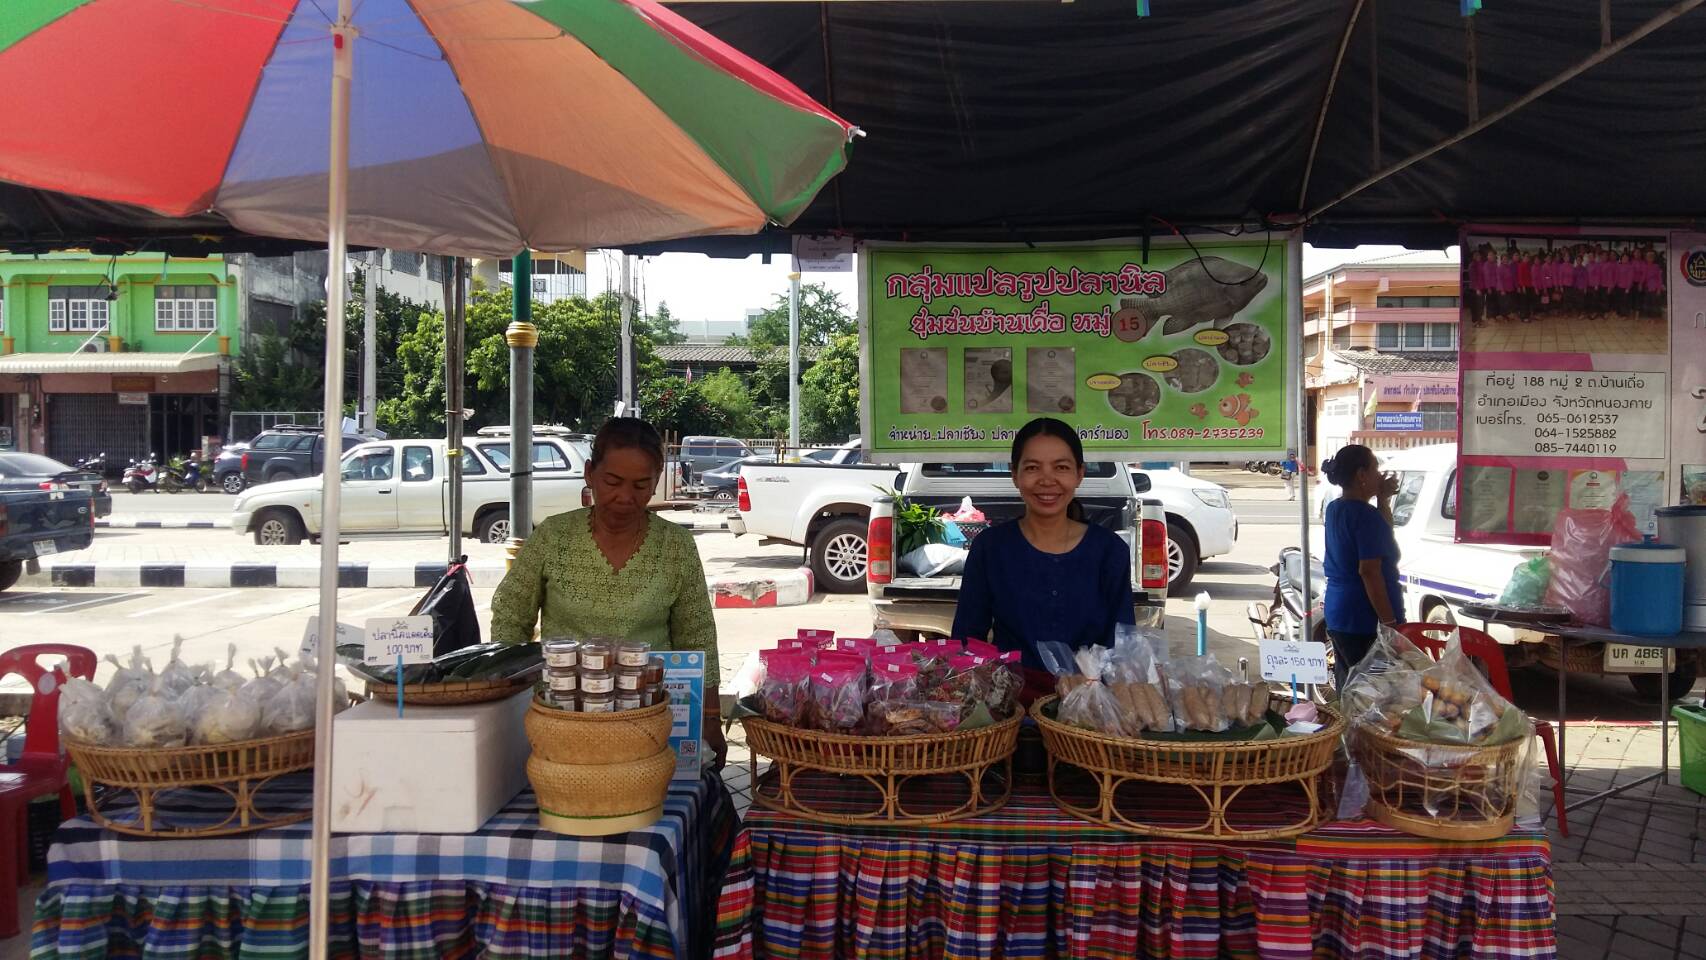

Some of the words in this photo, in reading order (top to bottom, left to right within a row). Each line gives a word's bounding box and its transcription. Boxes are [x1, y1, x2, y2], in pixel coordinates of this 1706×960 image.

[887, 264, 1167, 303] กลุ่มแปลรูปปลานิล
[1072, 305, 1113, 338] หมู่
[1119, 316, 1140, 331] 15
[1486, 371, 1515, 390] ที่อยู่
[1523, 376, 1545, 387] 188
[1550, 373, 1569, 391] หมู่
[1575, 377, 1583, 388] 2
[1477, 393, 1547, 408] อำเภอเมือง
[1552, 395, 1652, 410] จังหวัดหนองคาย
[1536, 412, 1619, 425] 065-0612537
[1534, 427, 1617, 440] 064-1525882
[1534, 442, 1617, 455] 085-7440119
[387, 644, 402, 655] 100
[405, 643, 423, 654] บาท
[1266, 655, 1288, 670] ถุงละ
[1291, 656, 1305, 666] 150
[1308, 657, 1325, 668] บาท
